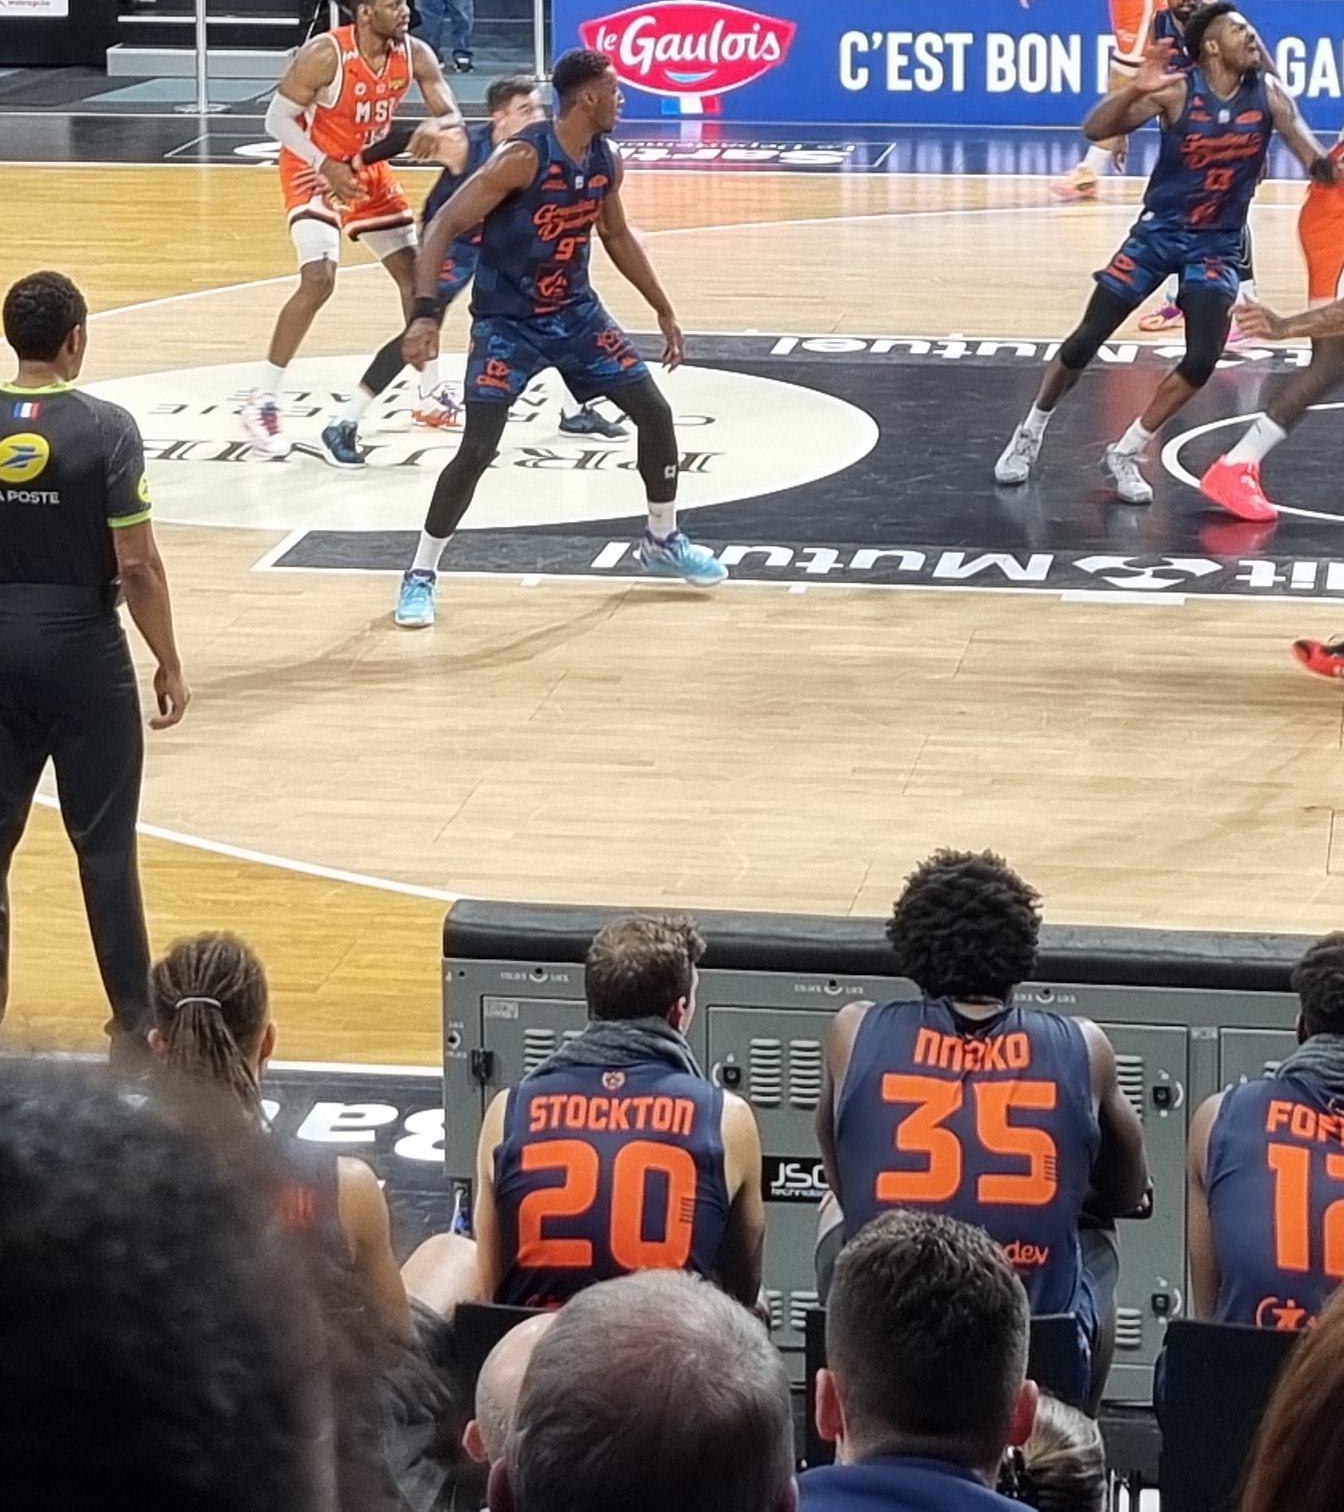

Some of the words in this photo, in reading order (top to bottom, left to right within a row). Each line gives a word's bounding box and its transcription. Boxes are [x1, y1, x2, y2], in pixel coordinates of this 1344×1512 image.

[596, 29, 617, 53] le
[617, 14, 784, 67] Gaulois
[985, 32, 1064, 94] BON
[6, 489, 61, 505] POSTE
[591, 541, 1055, 582] Mutul
[529, 1093, 695, 1136] STOCKTON
[875, 1073, 1057, 1206] 35
[517, 1139, 698, 1270] 20
